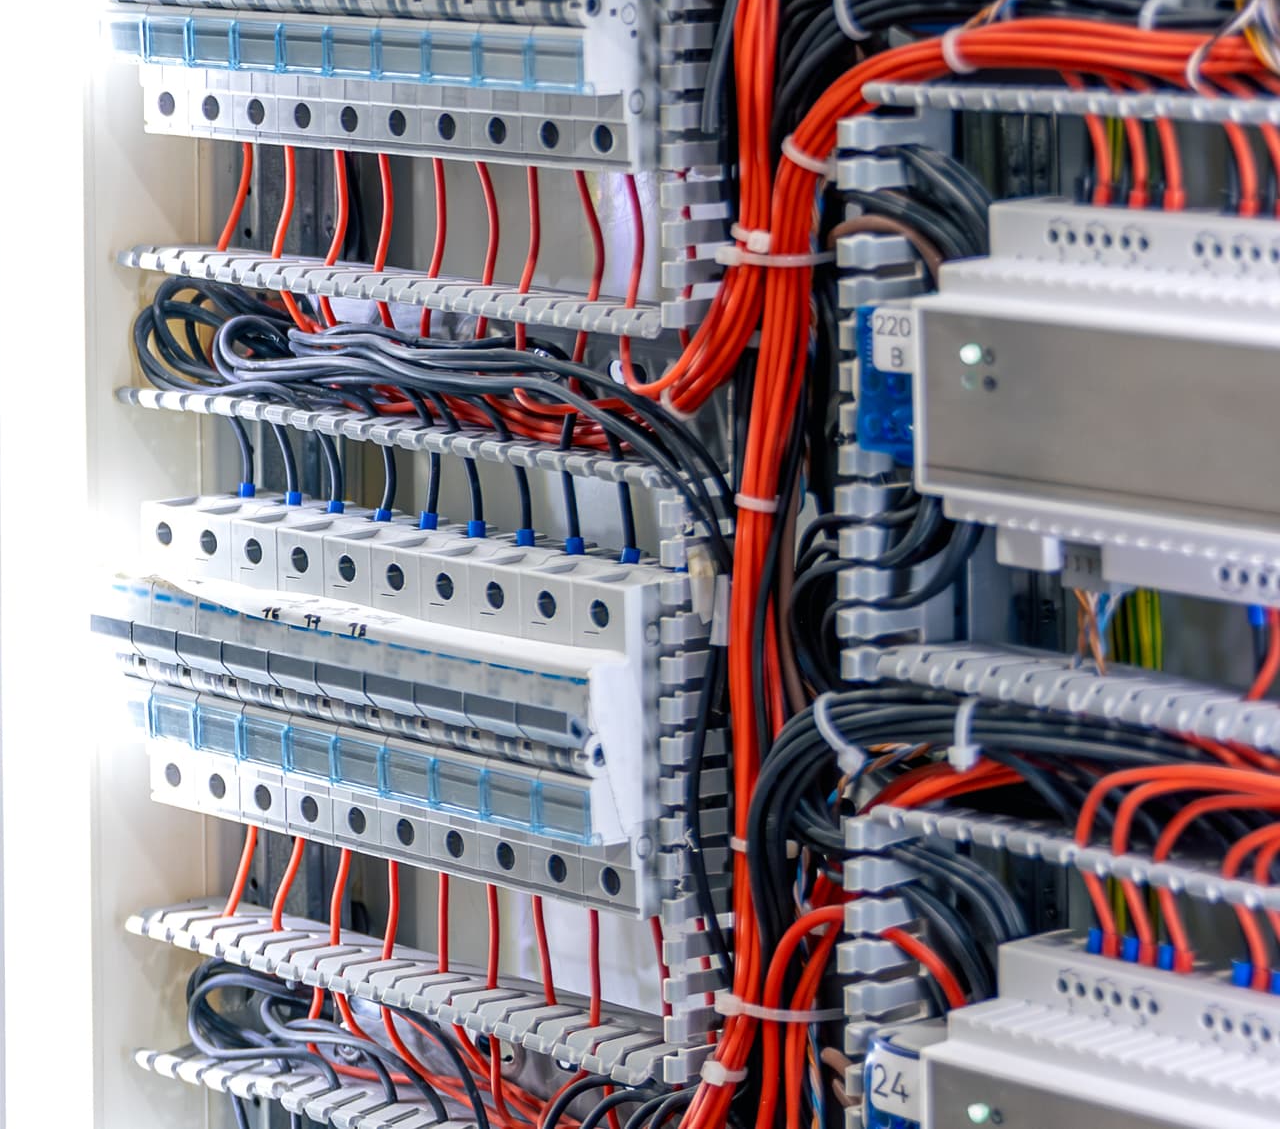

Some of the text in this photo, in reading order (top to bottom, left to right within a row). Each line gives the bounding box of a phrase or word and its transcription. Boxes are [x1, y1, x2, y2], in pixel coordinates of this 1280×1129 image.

[875, 314, 912, 337] 220
[890, 346, 905, 368] B
[872, 1062, 910, 1104] 24
